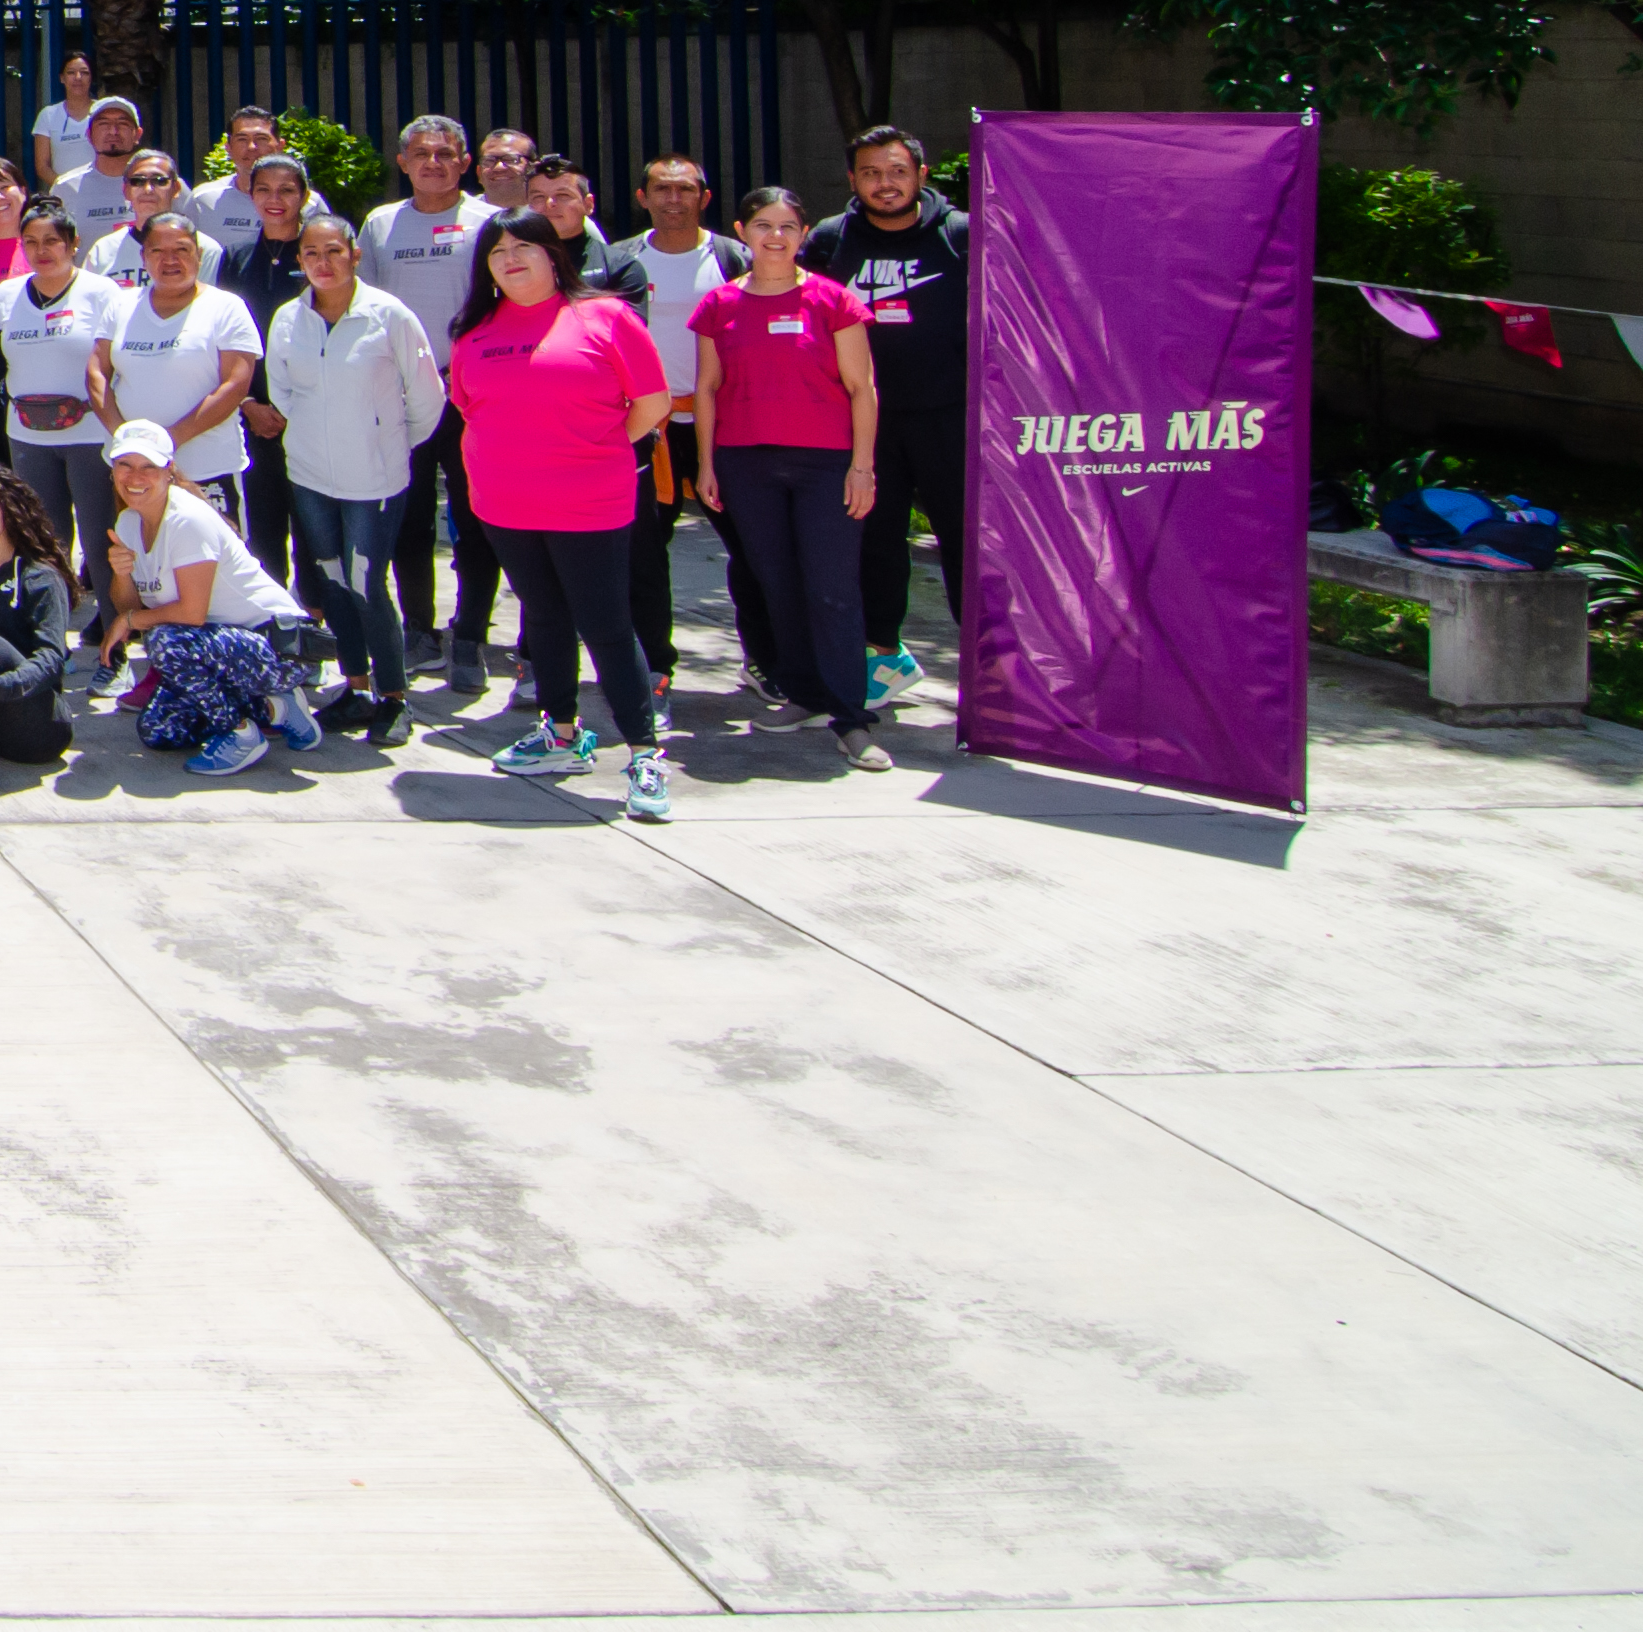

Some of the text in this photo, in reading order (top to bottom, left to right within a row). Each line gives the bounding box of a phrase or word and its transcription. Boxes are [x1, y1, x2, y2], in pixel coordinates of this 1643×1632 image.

[393, 247, 425, 260] JUEGA
[857, 259, 920, 285] NIKE
[1012, 400, 1266, 455] JUEGA MÁS
[1062, 460, 1211, 476] ESCUELAS ACTIVAS
